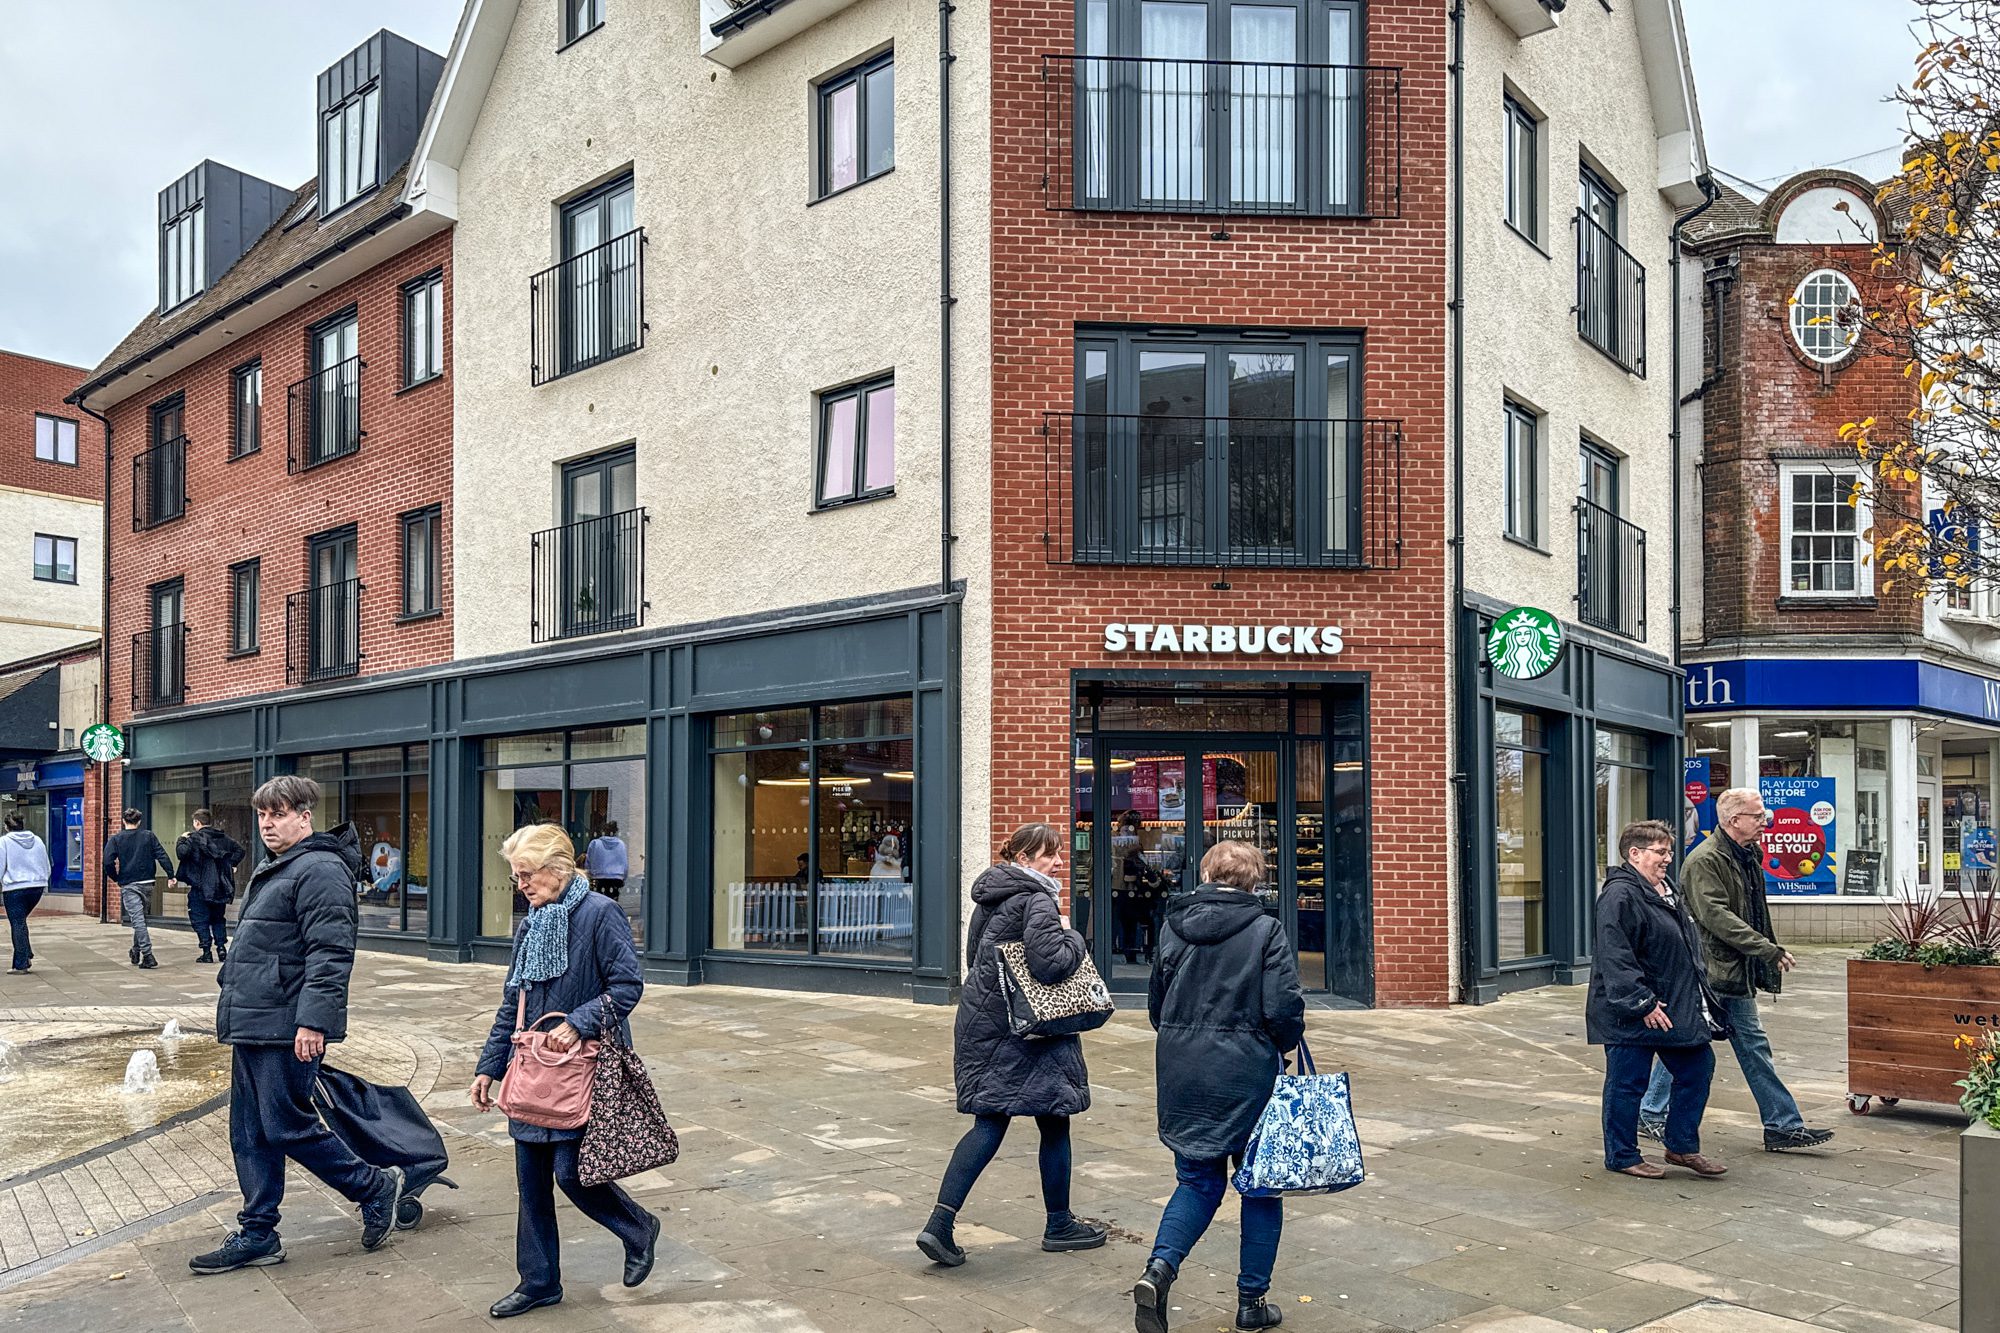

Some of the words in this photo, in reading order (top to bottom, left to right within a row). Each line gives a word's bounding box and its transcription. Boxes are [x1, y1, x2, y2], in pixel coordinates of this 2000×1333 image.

[1104, 623, 1344, 654] STARBUCKS
[1685, 665, 1735, 706] th
[1761, 780, 1786, 789] PLAY
[1788, 780, 1820, 789] LOTTO
[1761, 788, 1772, 797] IN
[1774, 788, 1806, 797] STORE
[1762, 797, 1787, 805] HERE
[1223, 830, 1243, 839] PICK
[1244, 830, 1256, 839] UP
[1761, 832, 1774, 843] IT
[1774, 832, 1818, 843] COULD
[1767, 843, 1784, 854] BE
[1785, 843, 1811, 854] YOU
[1777, 882, 1817, 890] WHSmith
[997, 961, 1007, 1000] undland
[1953, 1013, 2000, 1028] wet
